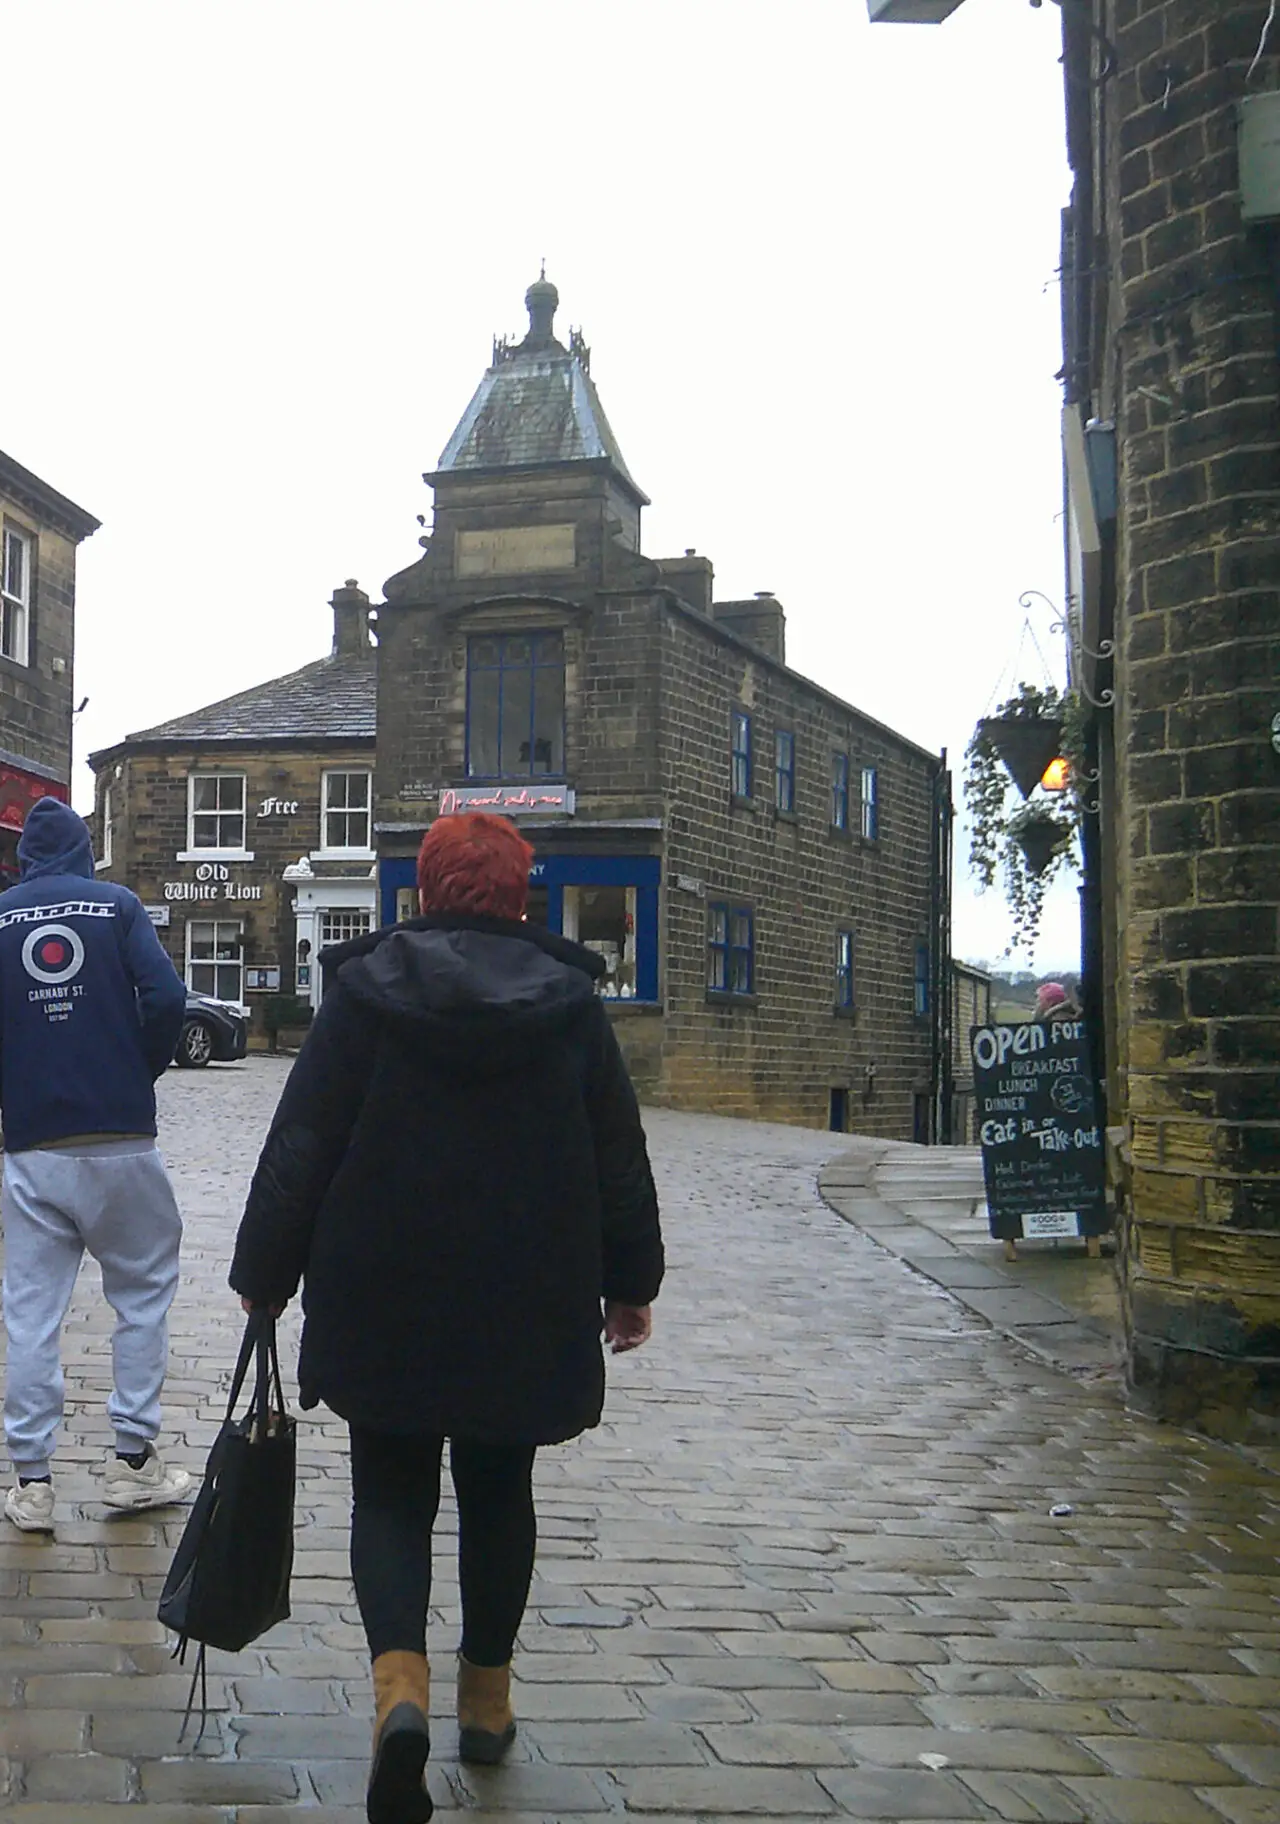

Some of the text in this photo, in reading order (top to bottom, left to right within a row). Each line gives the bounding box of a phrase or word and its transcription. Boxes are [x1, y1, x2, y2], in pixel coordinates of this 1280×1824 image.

[257, 797, 300, 818] Free
[195, 863, 230, 881] Old
[163, 882, 262, 901] White Lion
[28, 987, 69, 1002] CARNABY
[43, 1002, 74, 1014] LONDON
[1011, 1057, 1080, 1076] BREAKFAST
[998, 1078, 1038, 1094] LUNCH
[984, 1096, 1026, 1112] DINNER
[980, 1117, 1017, 1146] Eat
